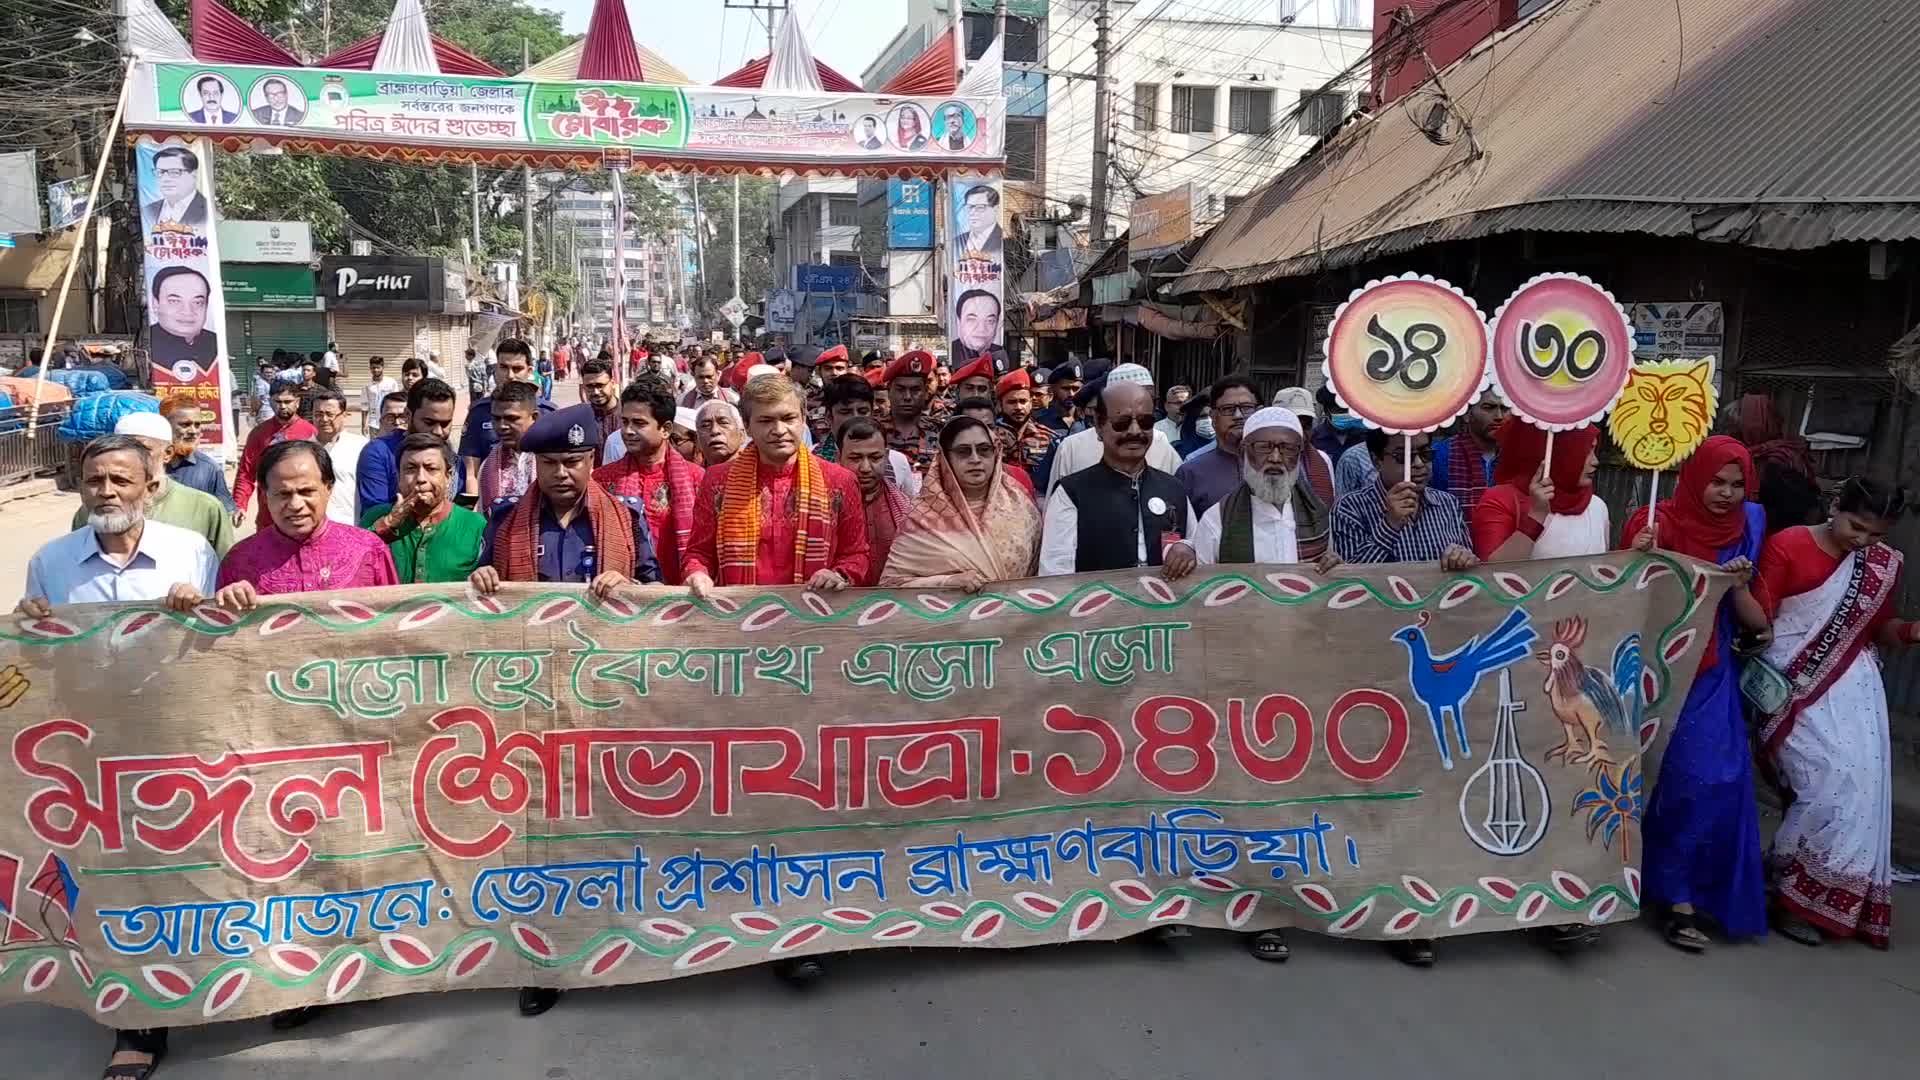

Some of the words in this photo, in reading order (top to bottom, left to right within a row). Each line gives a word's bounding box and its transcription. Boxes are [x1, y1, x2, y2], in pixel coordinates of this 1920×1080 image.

[401, 99, 453, 112] সর্বস্তরের
[460, 103, 516, 114] জনগণকে
[471, 86, 514, 98] জেলার
[577, 88, 641, 119] ঈদ
[335, 109, 386, 134] পবিত্র
[391, 113, 440, 135] ঈদের
[446, 119, 516, 137] শুভেচ্ছা
[550, 113, 673, 141] মোবারক
[336, 267, 412, 296] P-HUT
[1365, 312, 1447, 391] ১৪
[1516, 319, 1609, 382] ৩০
[268, 651, 451, 718] এসো
[464, 648, 557, 711] হে
[568, 620, 824, 709] বৈশাখ
[841, 636, 1003, 700] এসো
[1024, 621, 1192, 687] এসো
[12, 718, 392, 883] মঙ্গল
[471, 845, 650, 922] জেলা
[656, 843, 886, 913] প্রশাসন
